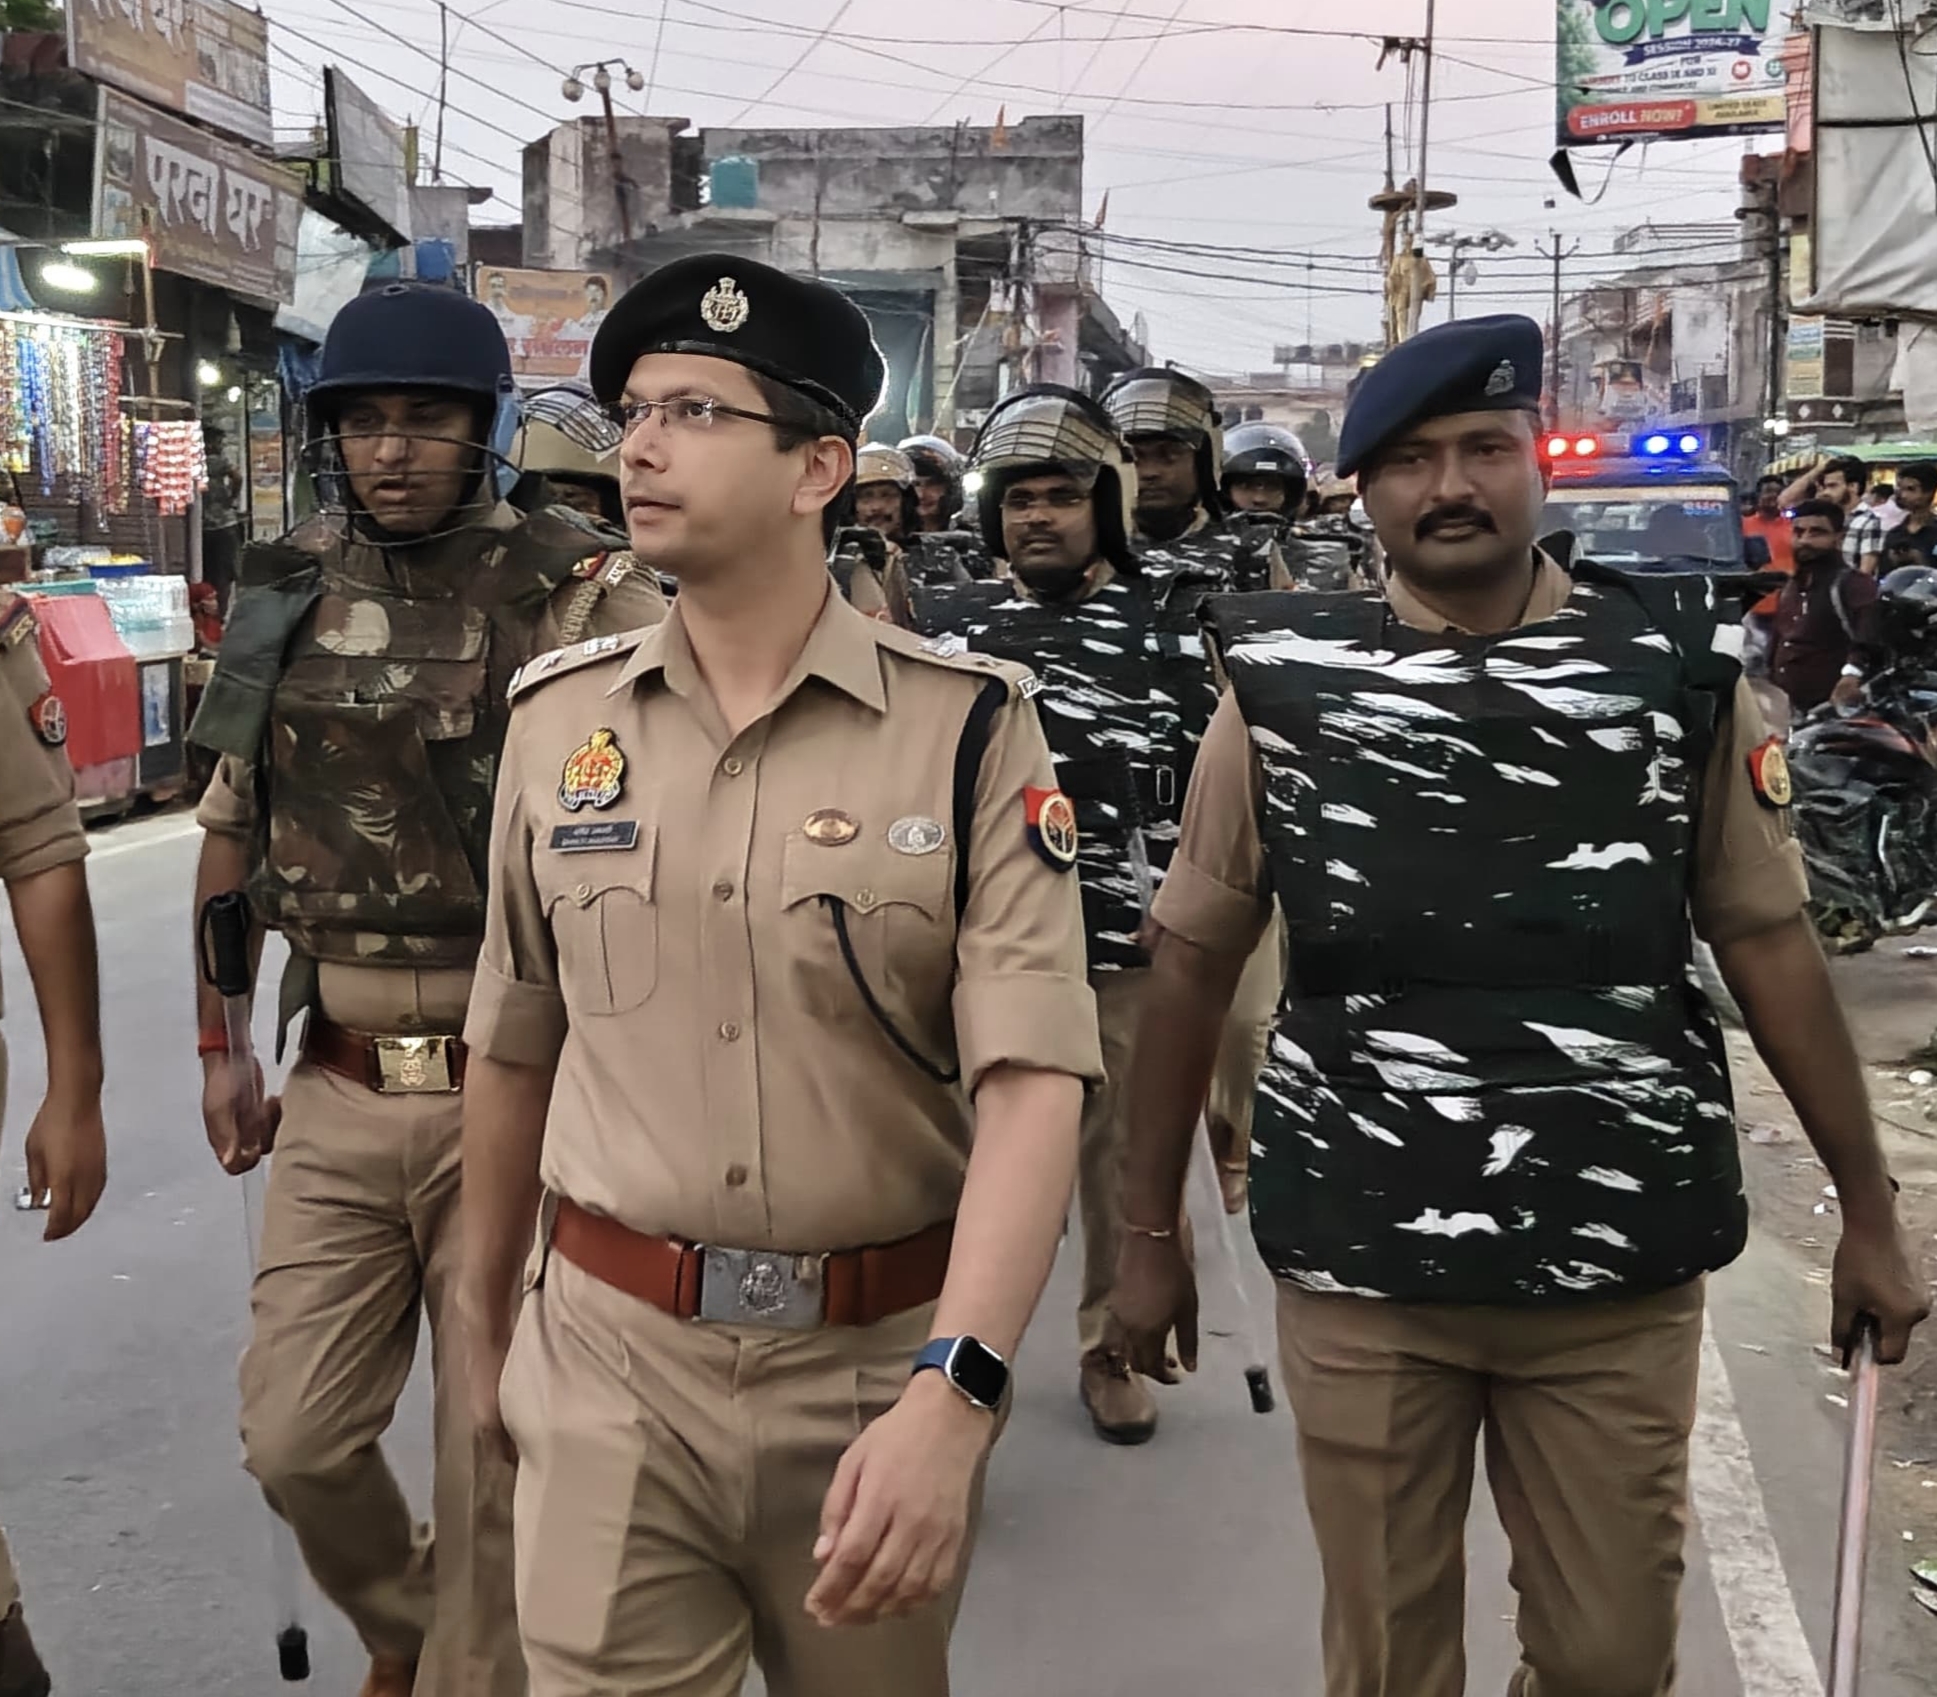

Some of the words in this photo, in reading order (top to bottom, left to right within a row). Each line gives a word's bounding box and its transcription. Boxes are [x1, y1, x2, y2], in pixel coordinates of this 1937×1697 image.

[1595, 0, 1769, 44] OPEN
[1580, 110, 1637, 129] ENROLL
[145, 136, 219, 244] परदा
[225, 168, 272, 251] घर
